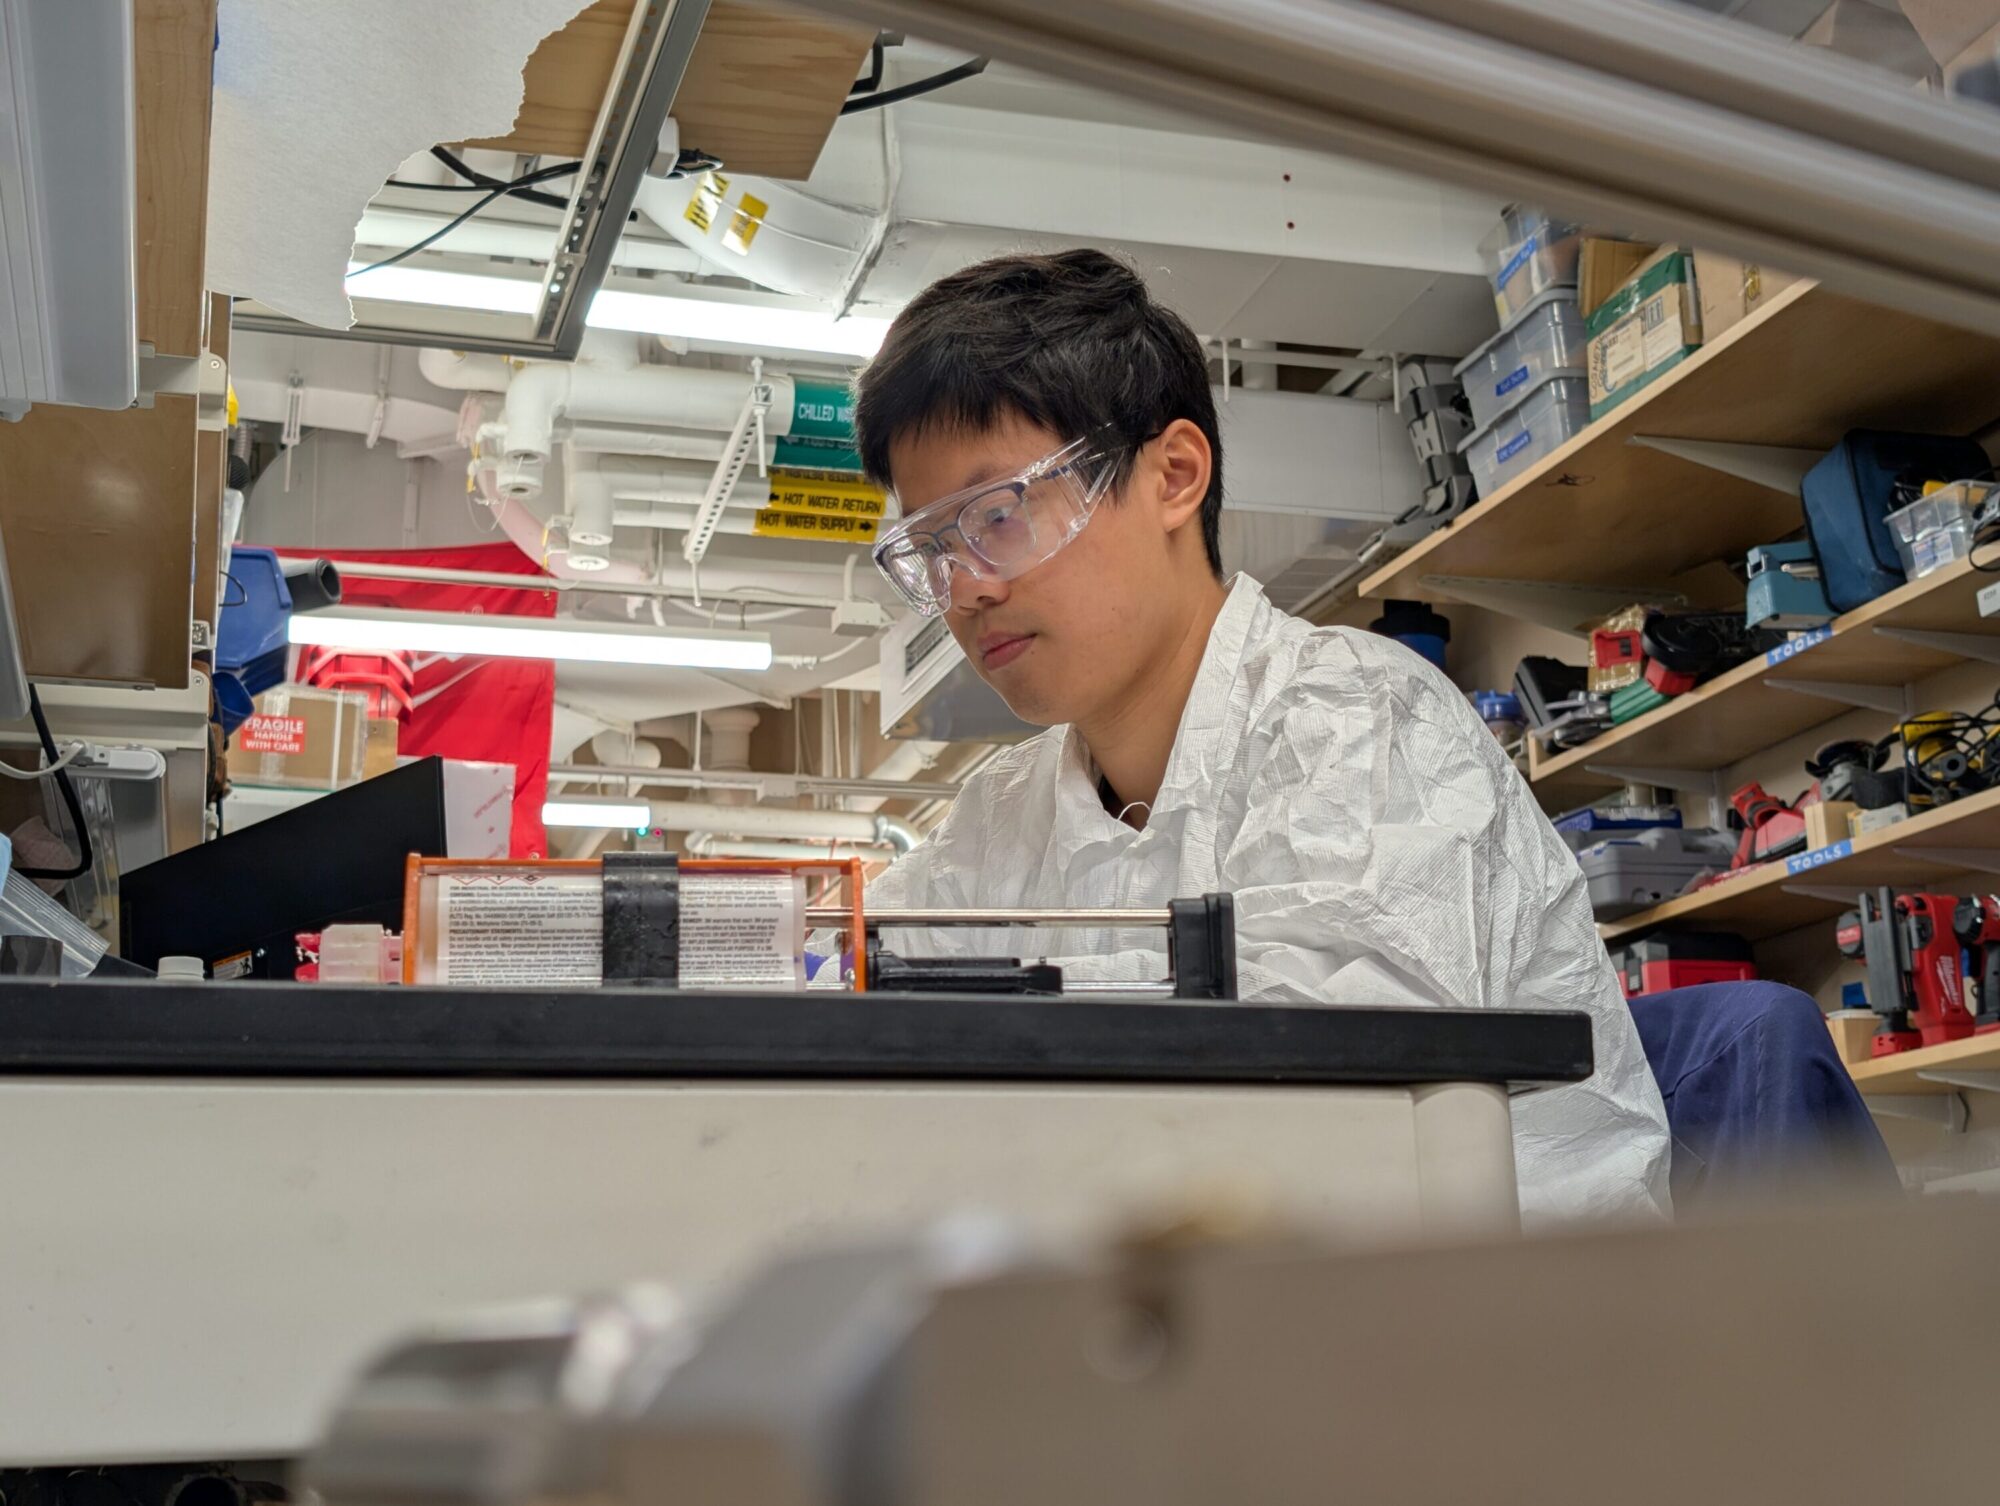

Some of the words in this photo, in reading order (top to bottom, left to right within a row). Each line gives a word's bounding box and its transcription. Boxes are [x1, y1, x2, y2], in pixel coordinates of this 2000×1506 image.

[798, 403, 835, 422] CHILLED
[783, 492, 803, 505] HOT
[807, 494, 839, 511] WATER
[841, 495, 882, 514] RETURN
[760, 514, 780, 527] HOT
[785, 516, 817, 530] WATER
[820, 517, 856, 532] SUPPLY
[1771, 629, 1824, 662] TOOLS
[245, 717, 304, 735] FRAGILE
[246, 739, 271, 750] WITH
[254, 729, 294, 742] HANDLE
[1791, 844, 1842, 872] TOOLS
